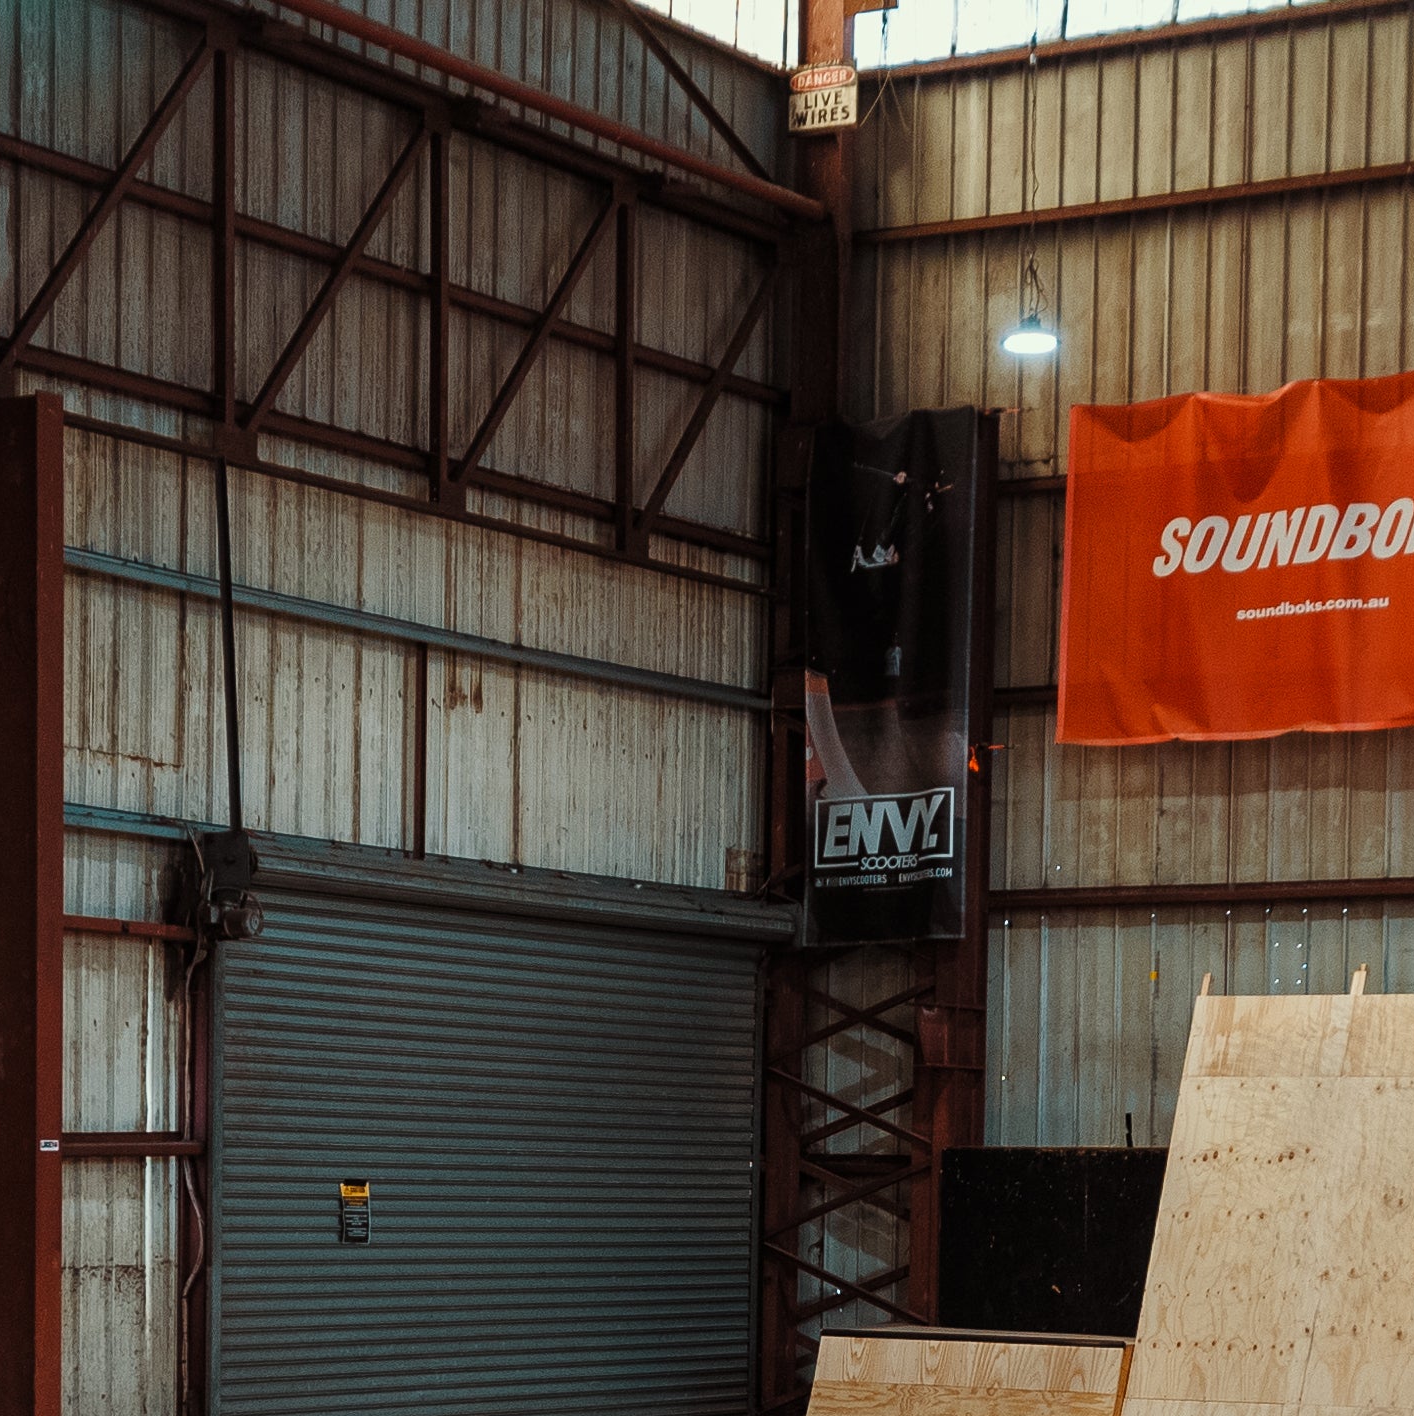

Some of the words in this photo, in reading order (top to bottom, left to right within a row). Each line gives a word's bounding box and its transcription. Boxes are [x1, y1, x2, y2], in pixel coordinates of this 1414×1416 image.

[798, 70, 846, 87] DANGER
[804, 91, 842, 109] LIVE
[795, 106, 849, 126] WIRES
[1236, 596, 1390, 621] soundboks.com.au
[860, 854, 918, 871] SCOOTERS
